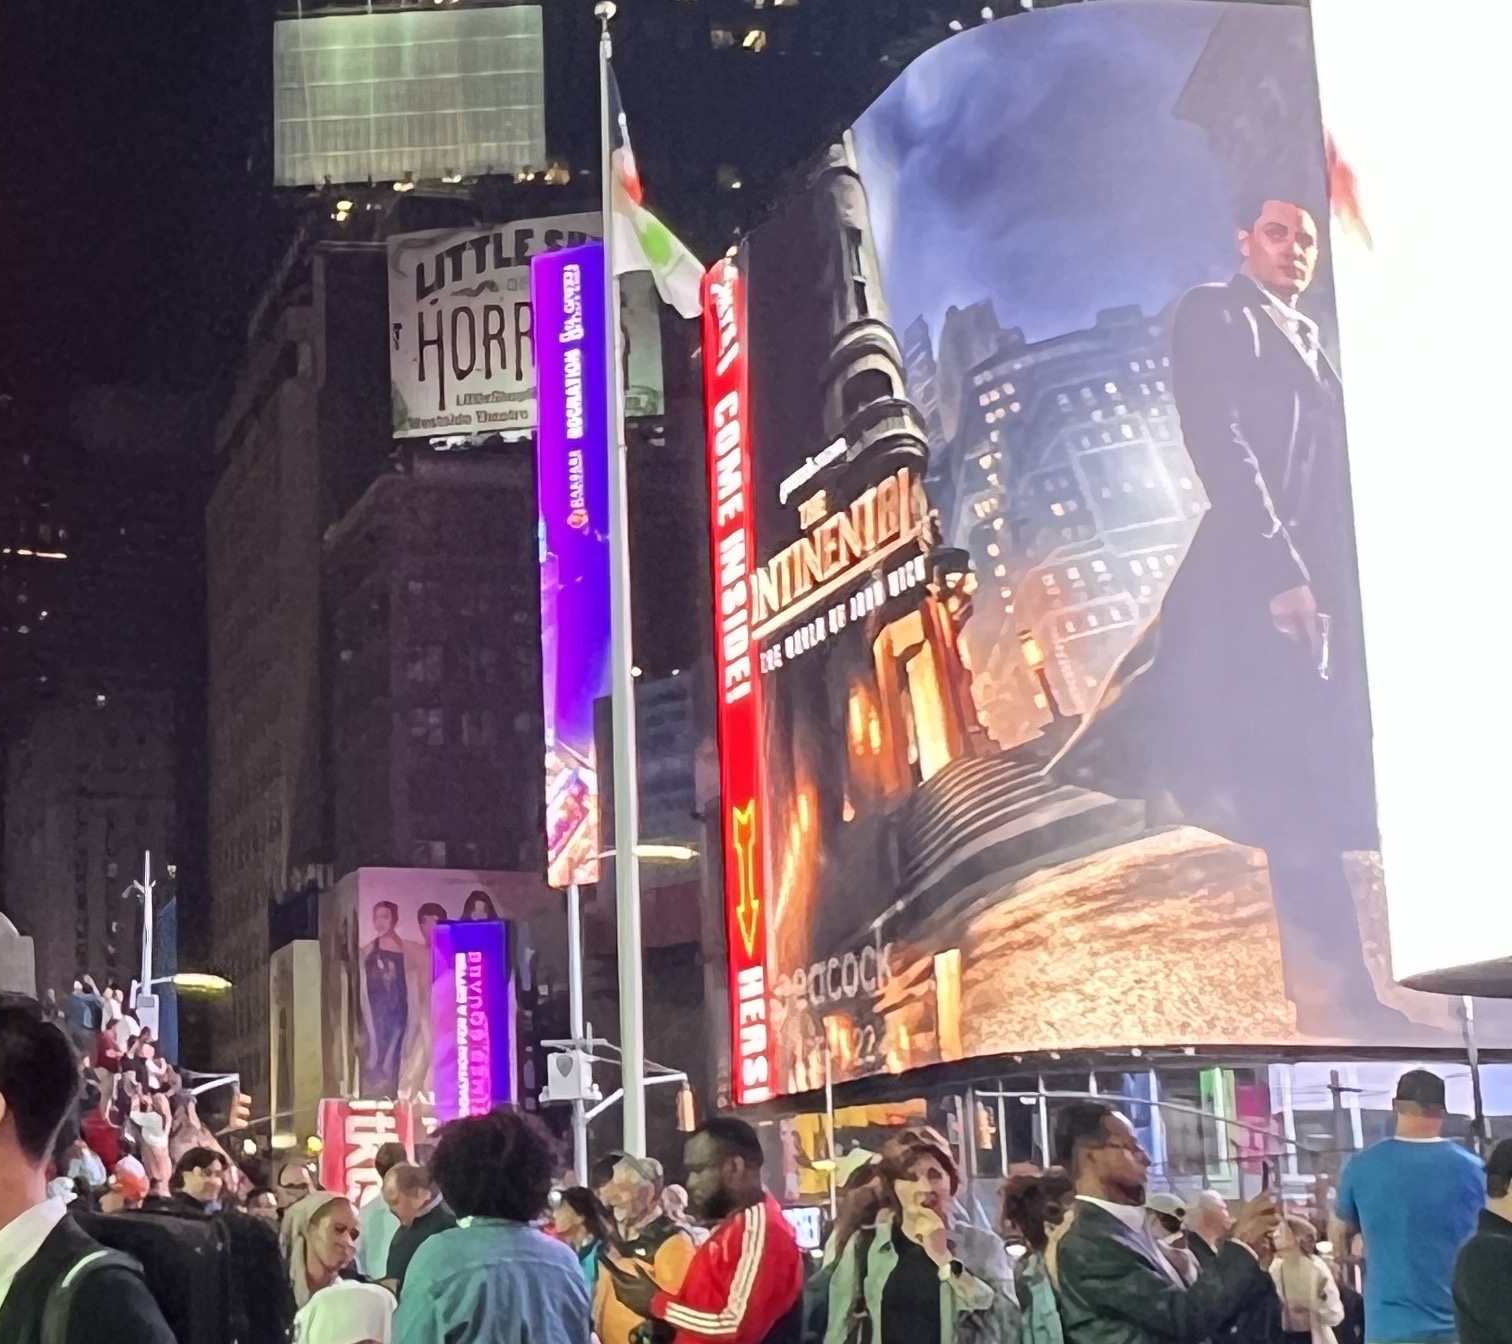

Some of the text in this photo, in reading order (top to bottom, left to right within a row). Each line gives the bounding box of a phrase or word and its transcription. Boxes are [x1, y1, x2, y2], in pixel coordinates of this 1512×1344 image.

[416, 229, 534, 303] LITTLE
[417, 301, 536, 411] HORR
[714, 390, 745, 527] COME
[750, 467, 914, 626] NTINENTAL
[719, 529, 753, 705] INSIDE!
